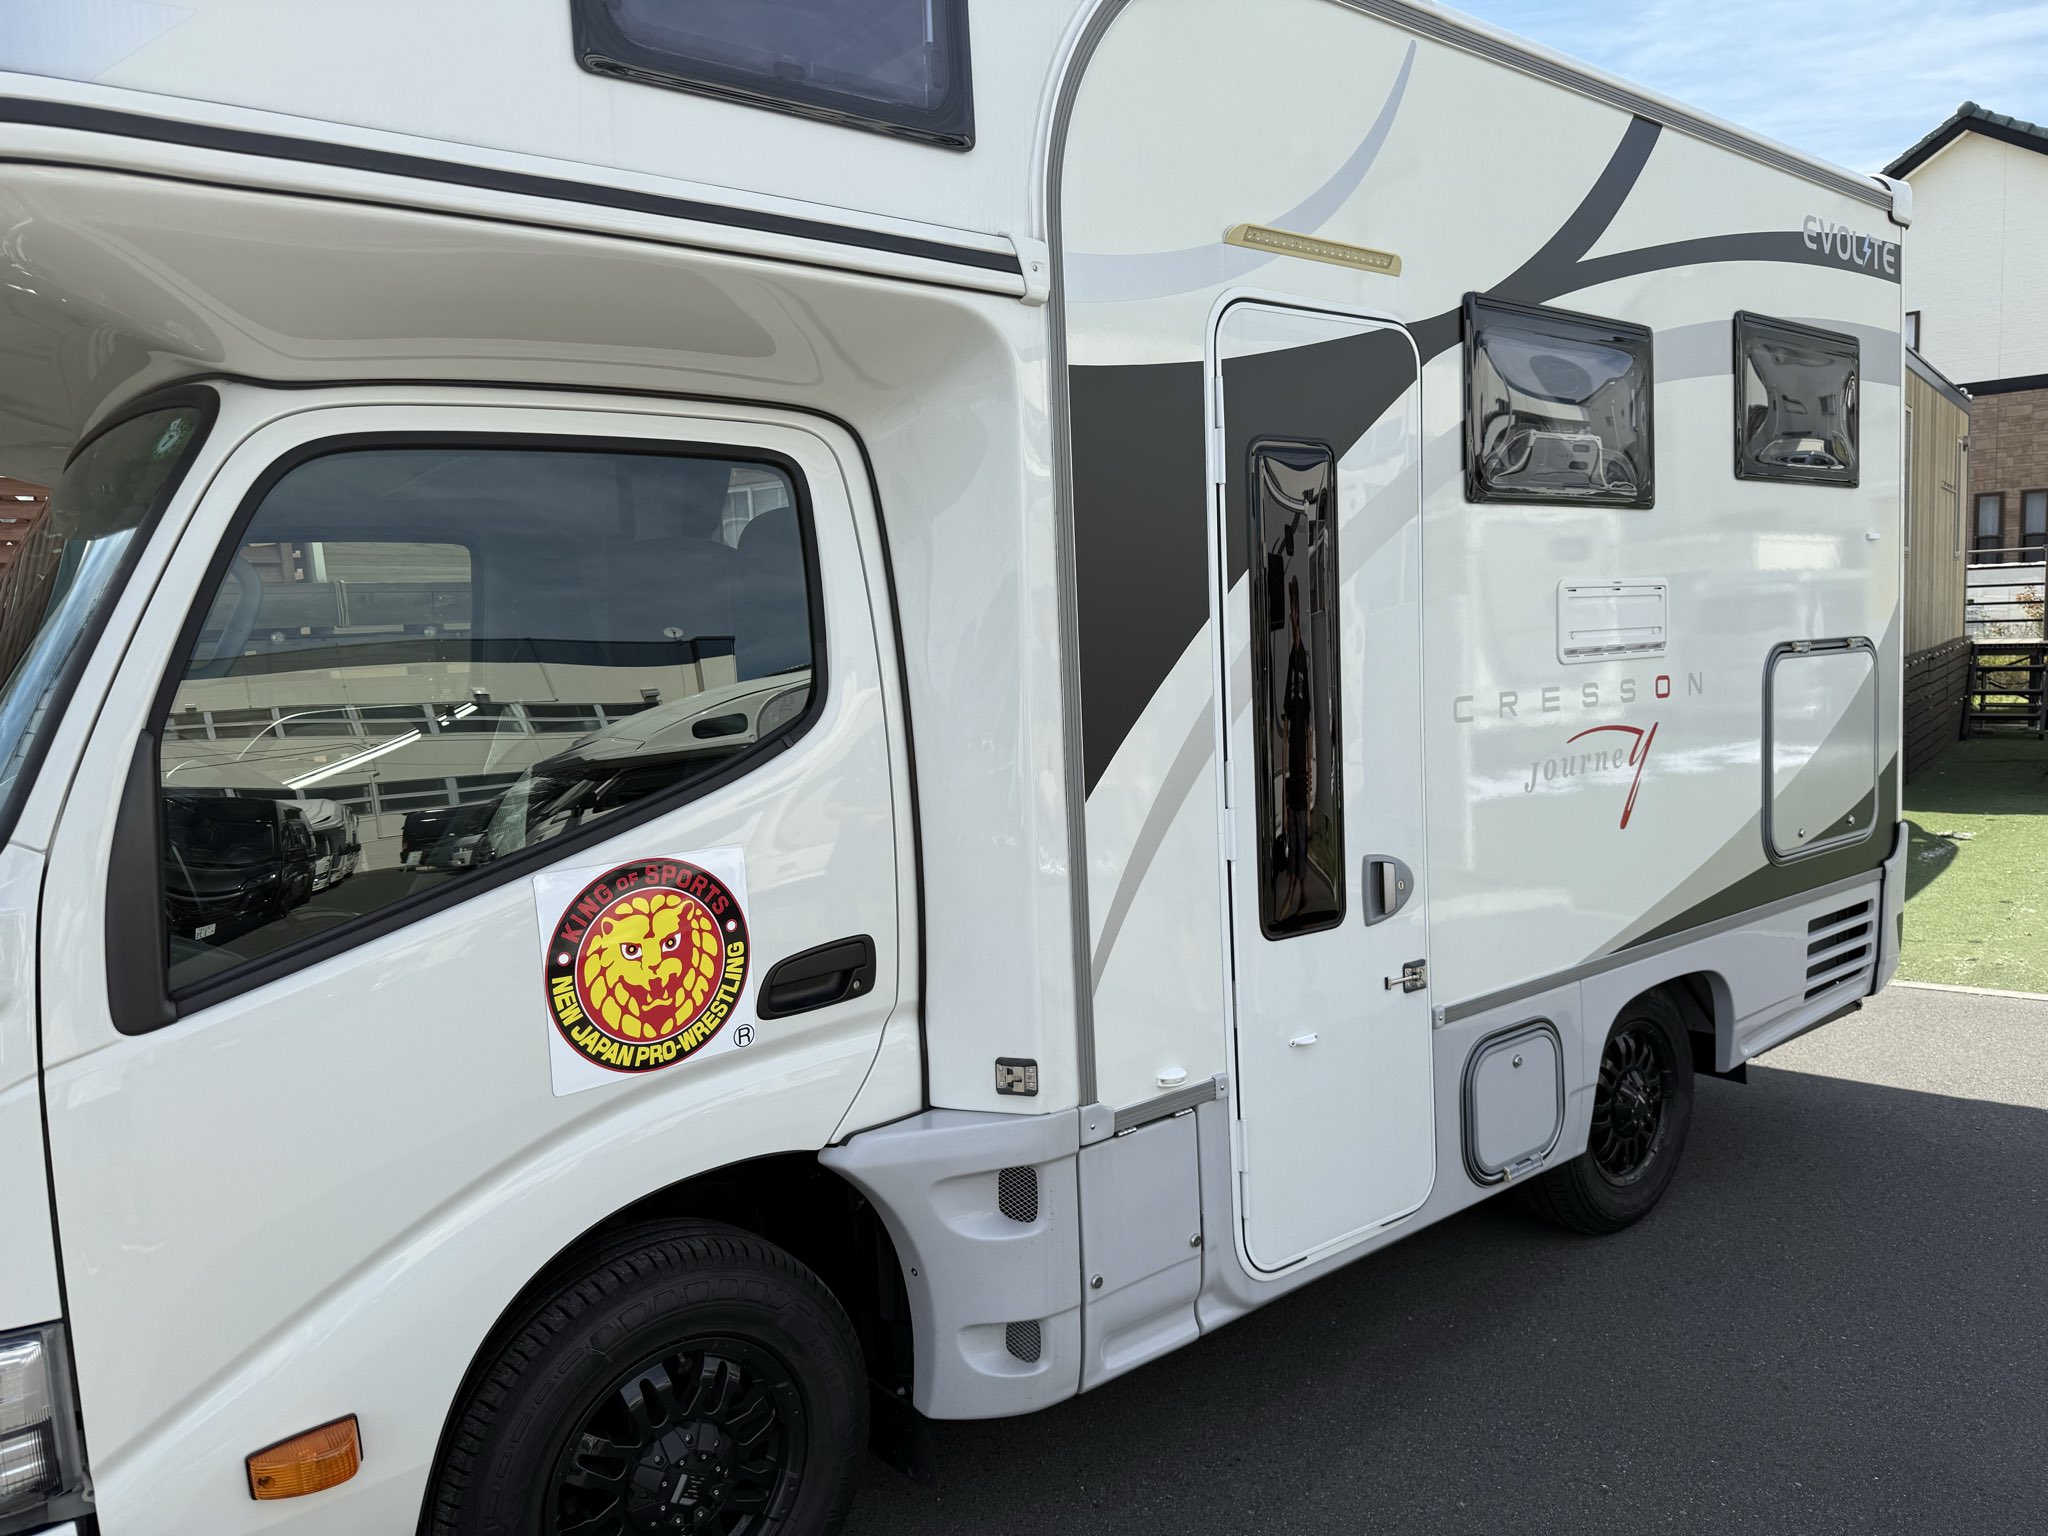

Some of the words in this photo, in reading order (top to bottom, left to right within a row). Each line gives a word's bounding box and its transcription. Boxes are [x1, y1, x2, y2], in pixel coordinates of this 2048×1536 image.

[1453, 671, 1703, 724] CRESSON
[1524, 721, 1659, 830] Journey
[561, 884, 614, 943] KING
[616, 871, 639, 892] OF
[644, 865, 729, 915] SPORTS
[552, 976, 583, 1026] NEW
[570, 1023, 634, 1067] JAPAN
[634, 940, 744, 1067] PRO-WRESTLING
